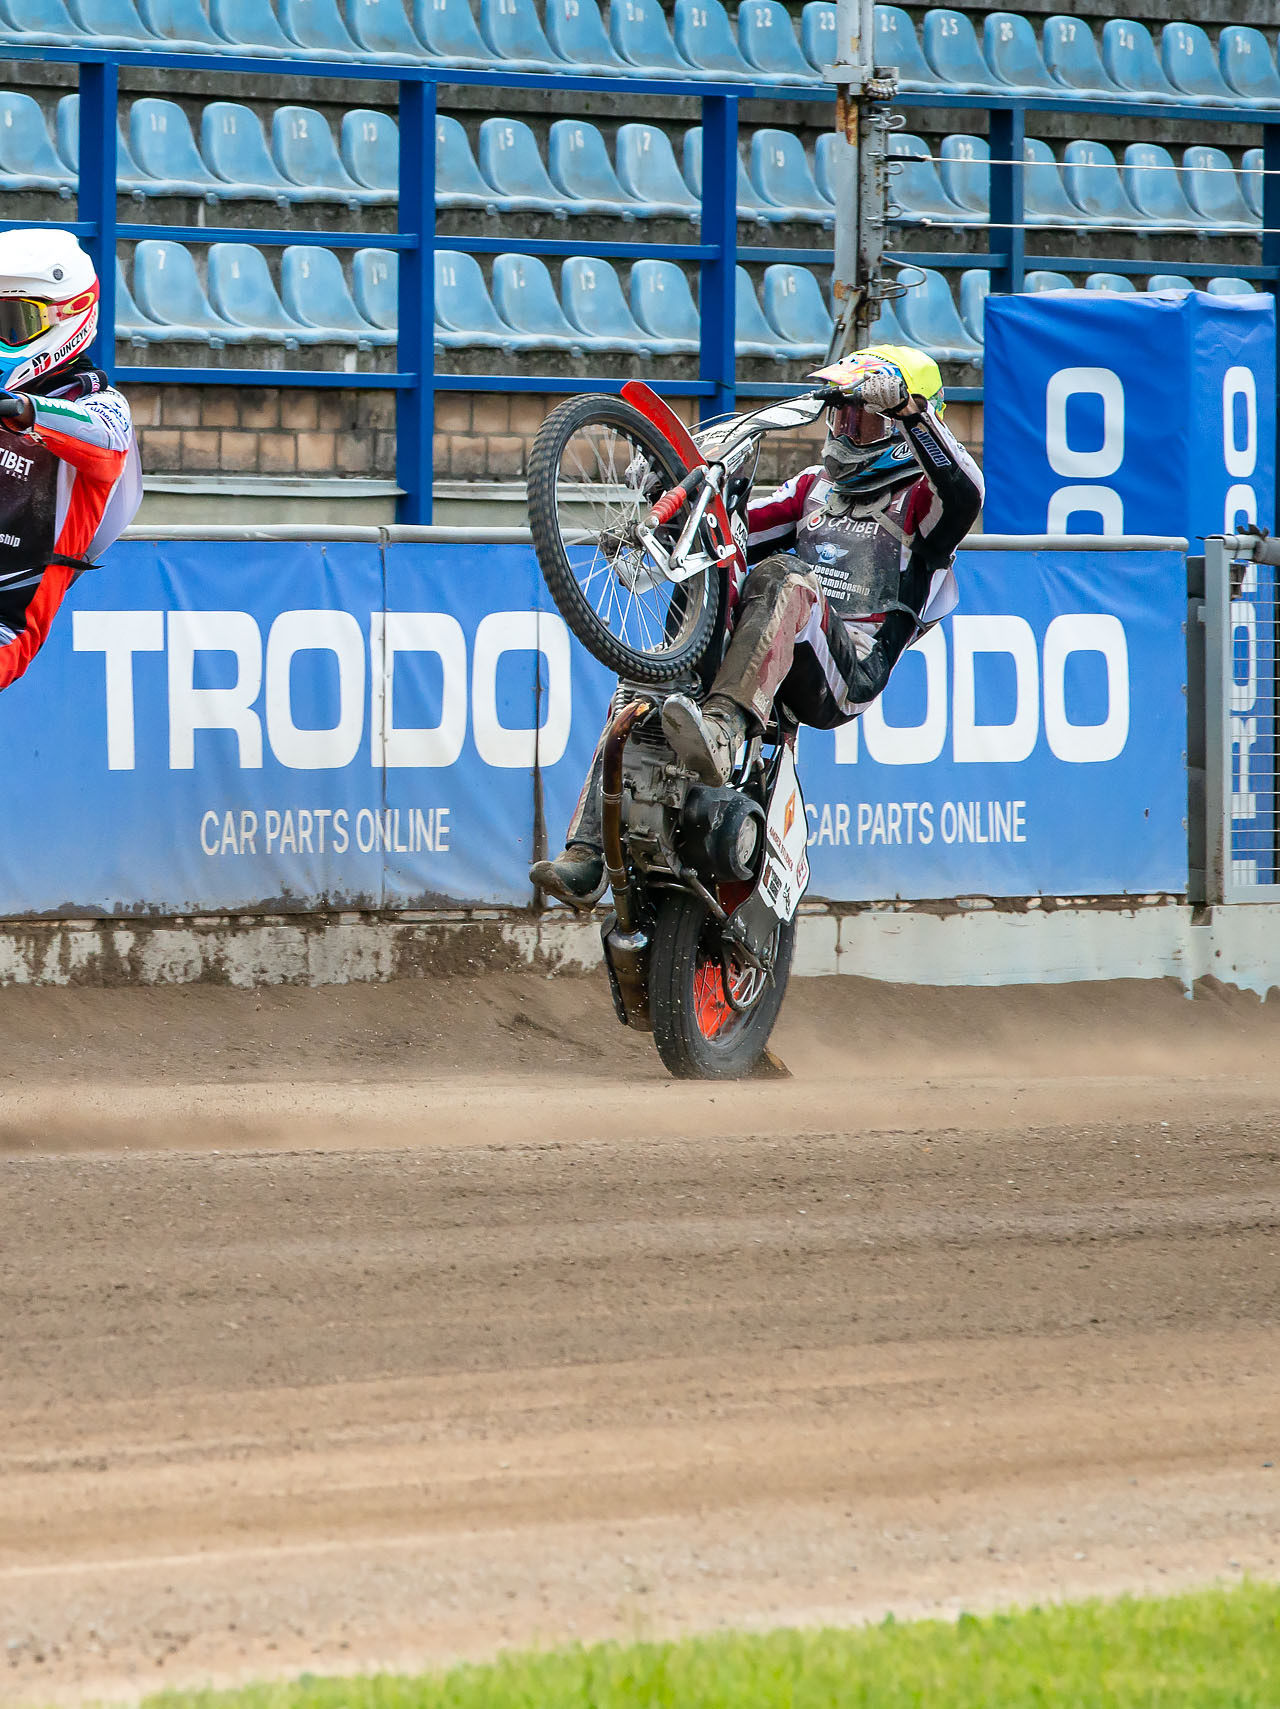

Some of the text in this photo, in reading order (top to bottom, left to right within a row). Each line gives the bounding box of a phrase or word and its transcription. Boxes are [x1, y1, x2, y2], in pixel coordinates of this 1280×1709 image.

[756, 8, 772, 27] 22
[820, 12, 836, 31] 23
[941, 18, 958, 36] 25
[828, 514, 880, 536] OPTIBET
[73, 610, 572, 770] TRODO
[201, 808, 450, 856] CAR PARTS ONLINE
[806, 800, 1027, 847] CAR PARTS ONLINE
